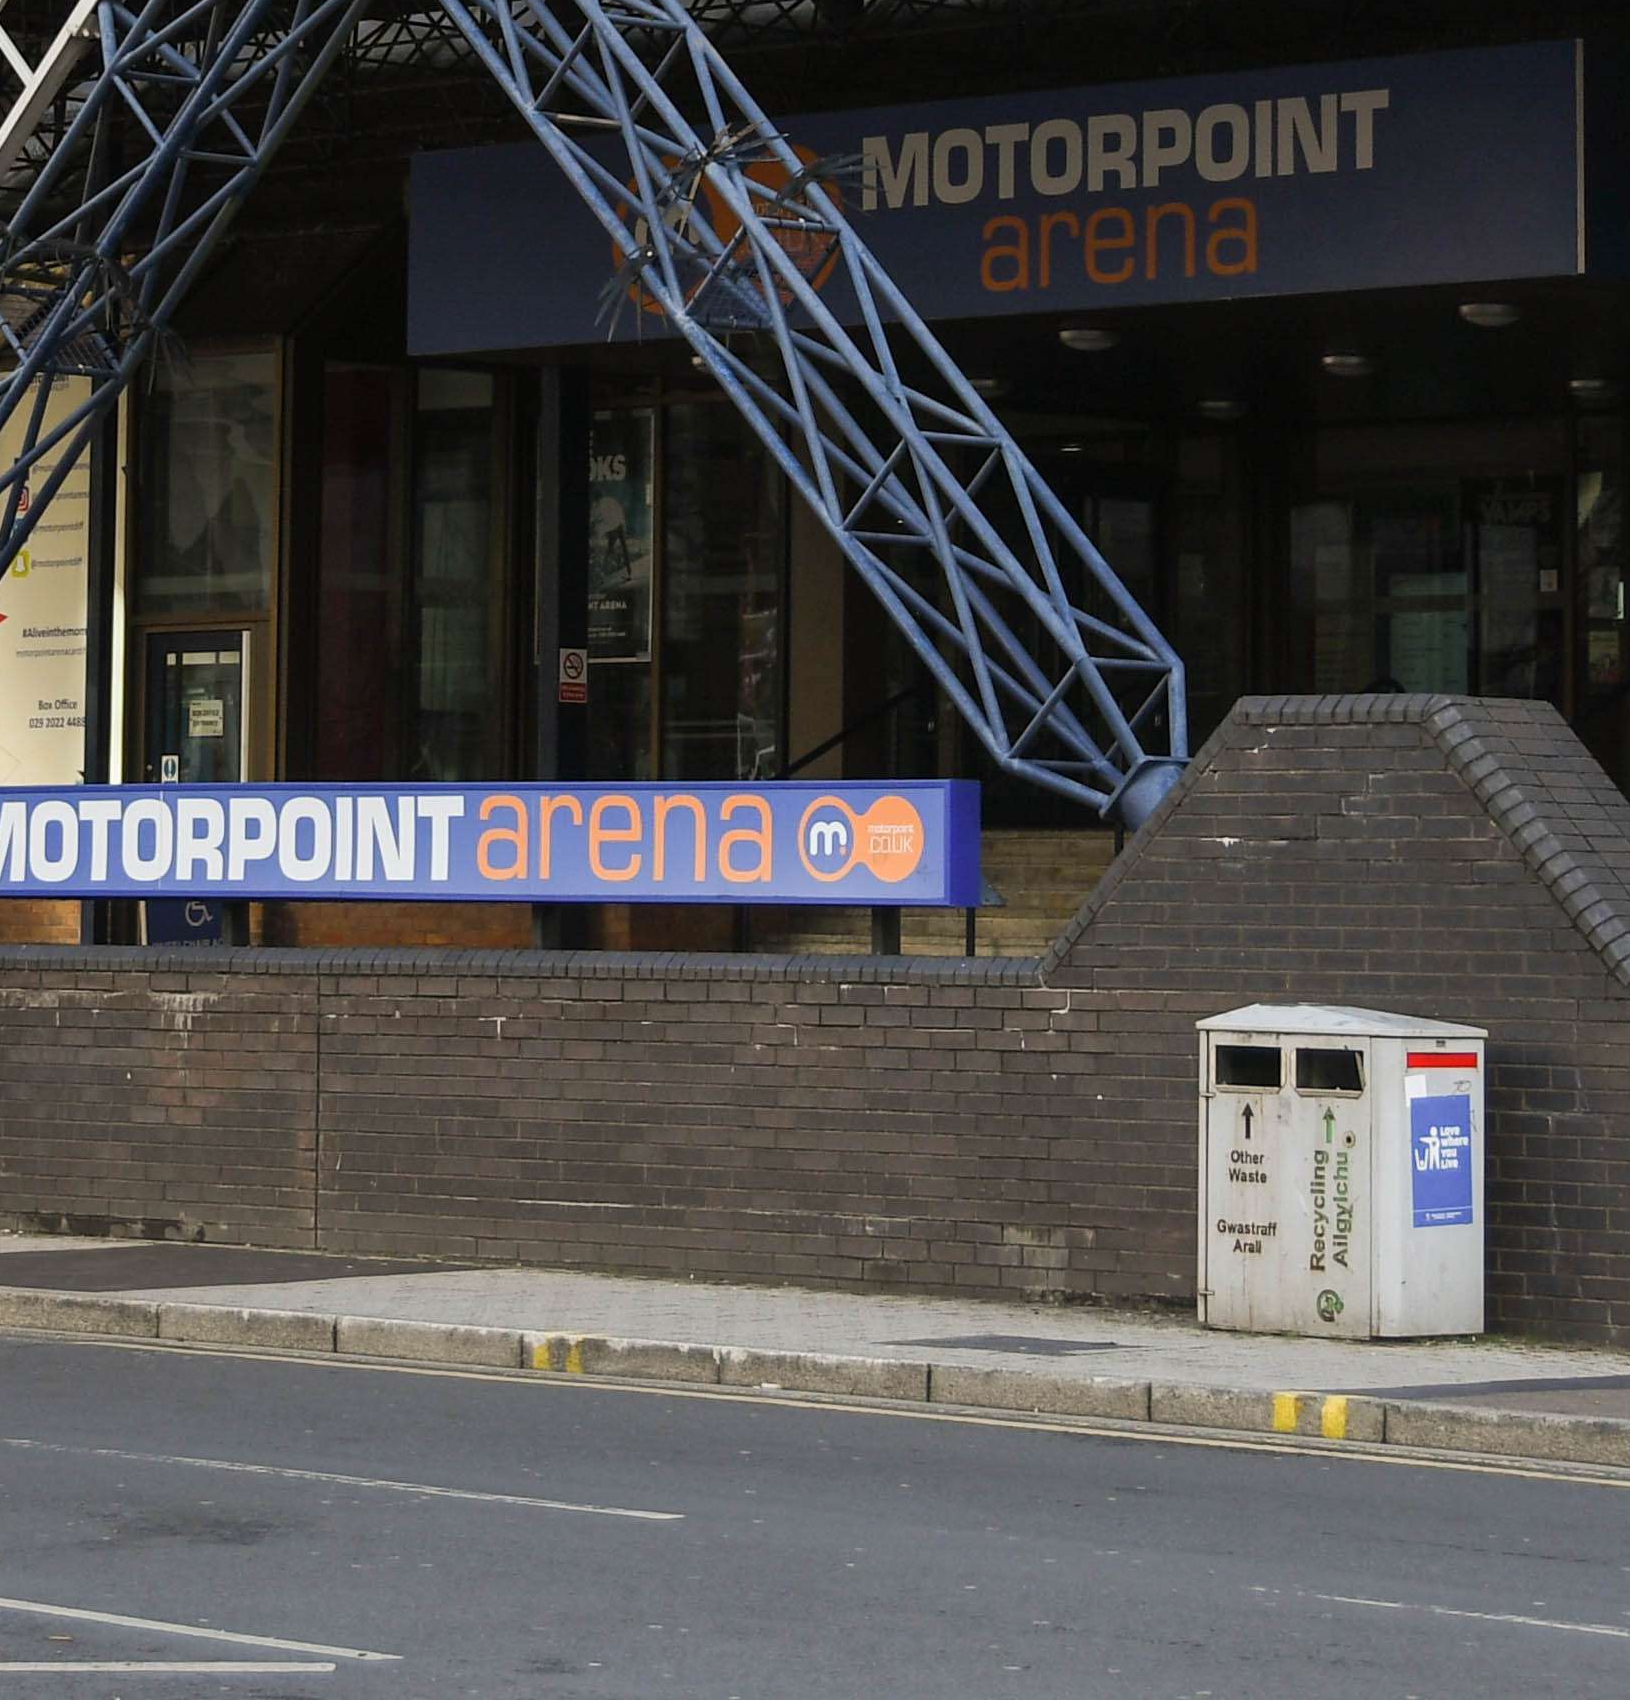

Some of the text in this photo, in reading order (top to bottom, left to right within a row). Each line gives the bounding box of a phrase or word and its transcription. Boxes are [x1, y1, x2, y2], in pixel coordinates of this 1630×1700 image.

[862, 88, 1389, 210] MOTORPOINT
[981, 197, 1259, 293] arena
[38, 698, 78, 711] Box Office
[476, 793, 773, 884] arena
[1228, 1168, 1268, 1184] Waste
[1229, 1149, 1265, 1166] Other
[1216, 1218, 1278, 1238] Gwastraff
[1309, 1149, 1329, 1272] Recycling
[1332, 1150, 1353, 1268] Ailgylchu
[1232, 1237, 1262, 1254] Arall
